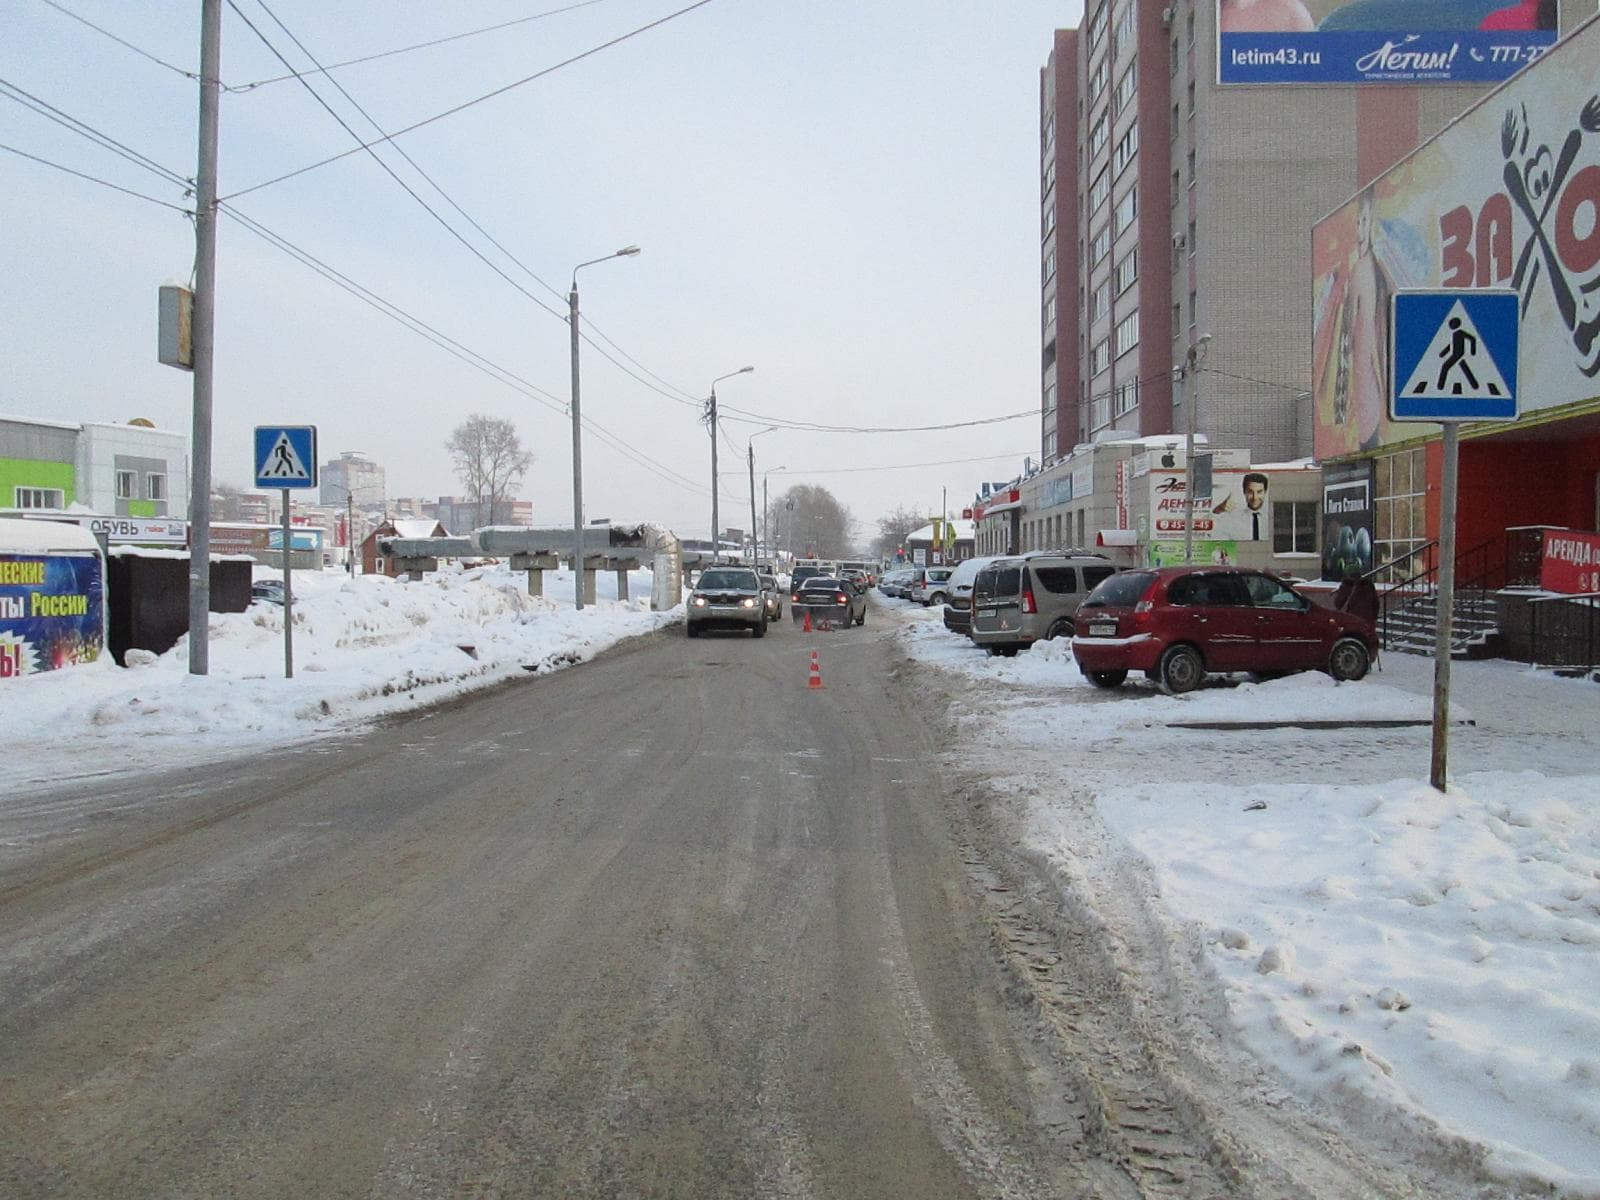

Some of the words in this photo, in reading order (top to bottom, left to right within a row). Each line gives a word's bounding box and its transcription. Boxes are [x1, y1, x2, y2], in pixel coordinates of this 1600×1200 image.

[1232, 47, 1321, 66] letim43.ru
[1355, 41, 1459, 71] Летим!
[1158, 498, 1212, 511] ДЕНГИ
[91, 519, 139, 536] ОБУВЬ
[1545, 538, 1592, 567] АРЕНДА
